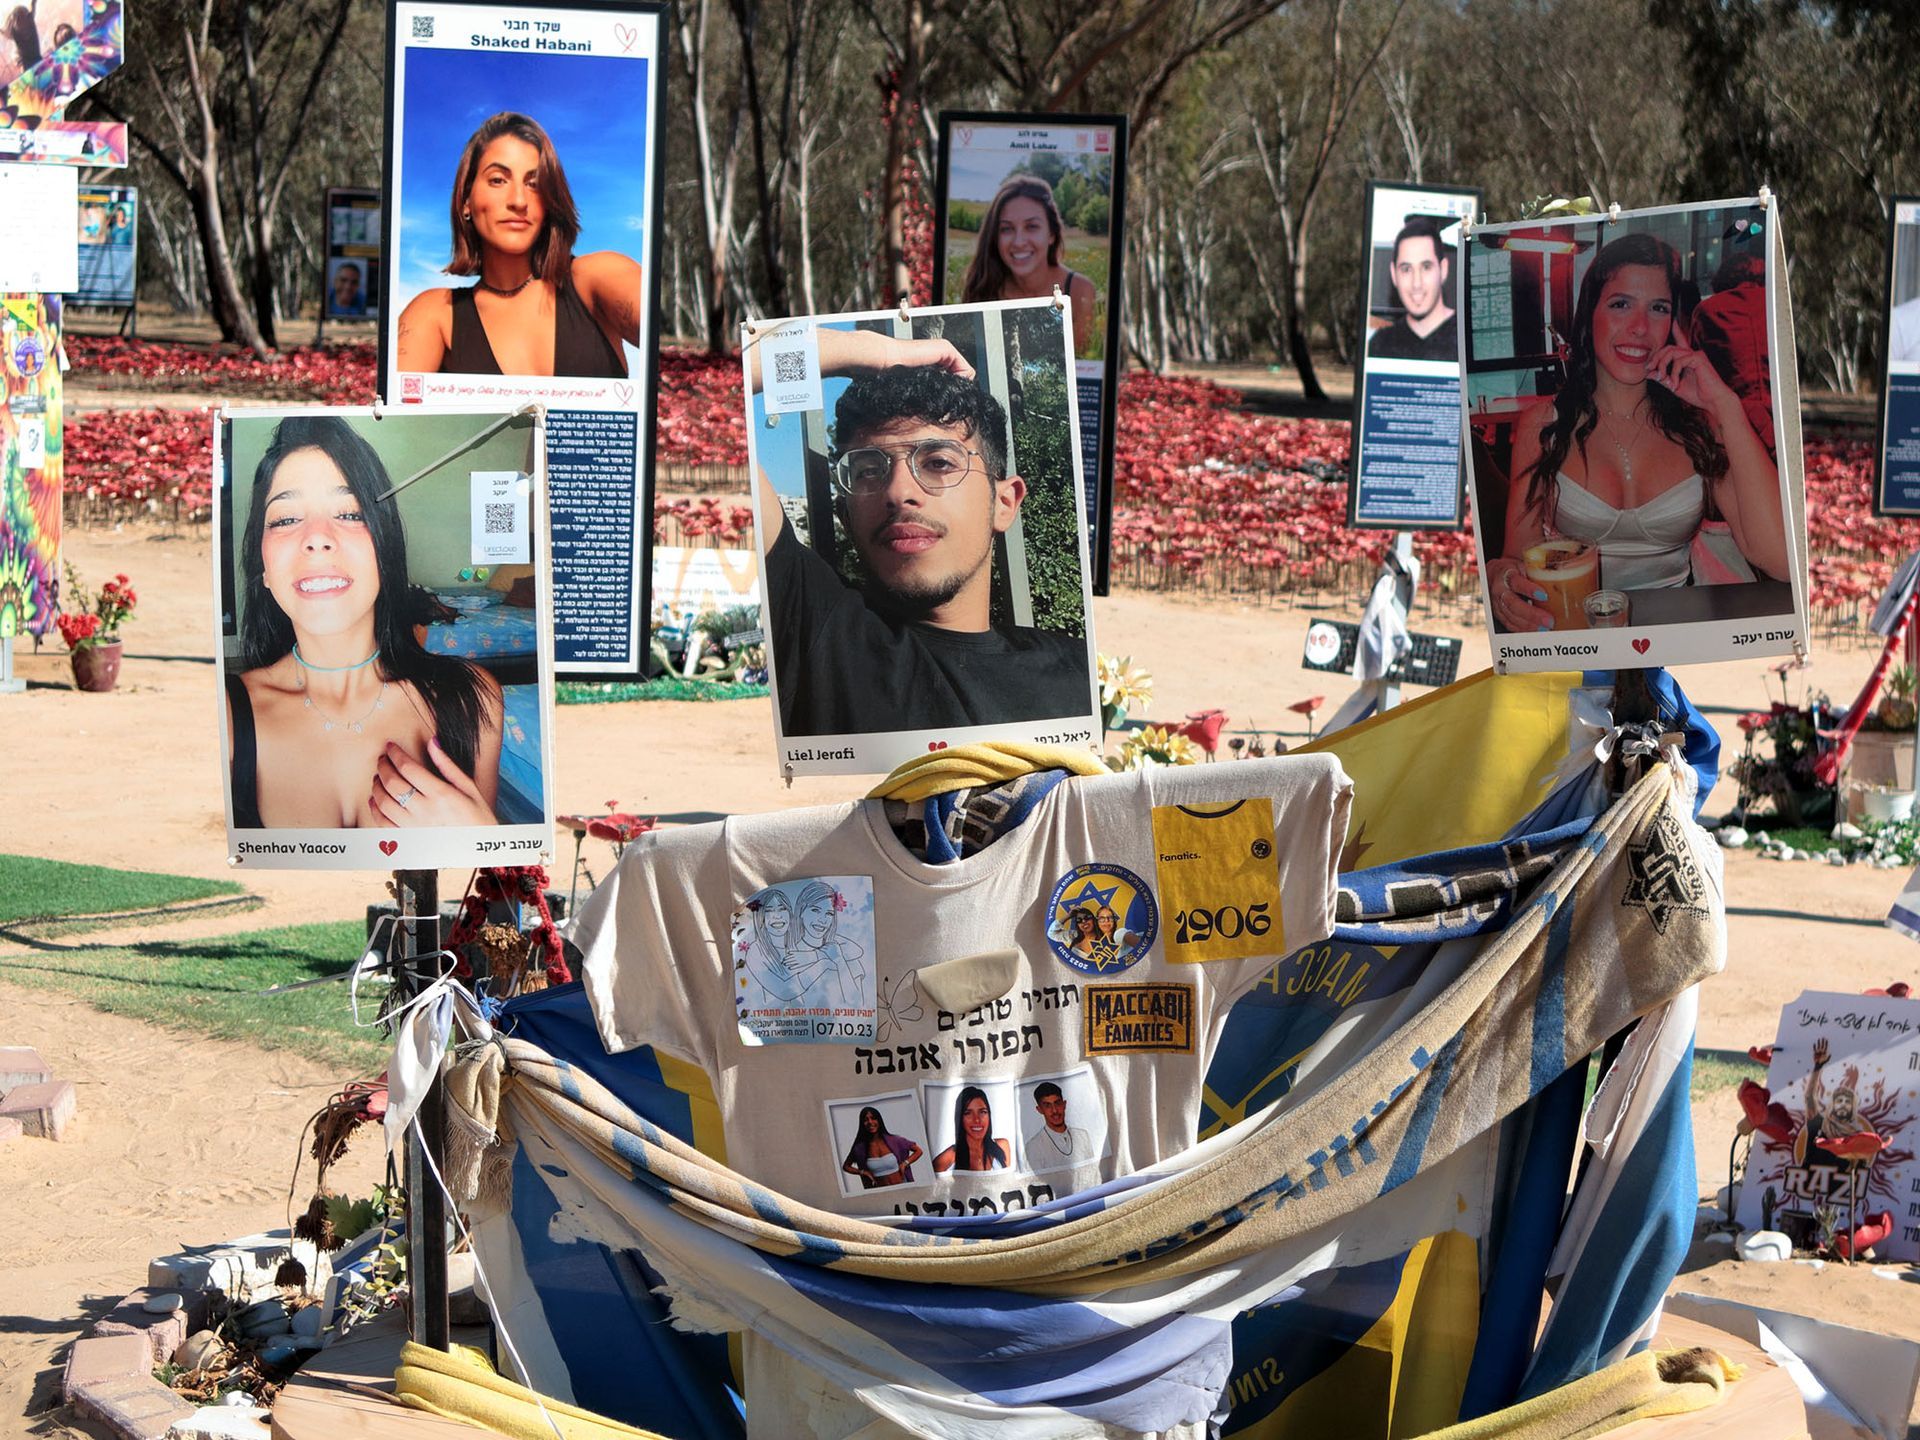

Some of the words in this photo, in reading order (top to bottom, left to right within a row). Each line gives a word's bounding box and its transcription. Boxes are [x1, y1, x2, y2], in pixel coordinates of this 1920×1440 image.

[503, 20, 529, 31] חבני
[533, 21, 560, 33] שקד
[471, 34, 530, 49] Shaked
[535, 38, 592, 52] Habani
[1009, 141, 1030, 149] Amit
[1032, 142, 1058, 150] Lahav
[1732, 631, 1762, 645] יעקב
[1766, 629, 1795, 642] שהם
[1500, 645, 1552, 659] Shoham
[1557, 644, 1599, 657] Yaacov
[1063, 730, 1091, 743] ליאל
[787, 749, 814, 762] Liel
[816, 748, 855, 761] Jerafi
[238, 842, 296, 855] Shenhav
[299, 842, 346, 855] Yaacov
[475, 840, 506, 854] יעקב
[510, 839, 543, 851] שנהב
[1159, 851, 1202, 862] Fanatics.
[1174, 902, 1271, 944] 1906
[1069, 957, 1089, 970] 2023
[1022, 984, 1079, 1011] תהיו
[1095, 992, 1183, 1027] MACCABI
[1868, 1012, 1887, 1031] לא
[816, 1022, 873, 1037] 07.10.23
[1105, 1023, 1174, 1043] FANATICS
[953, 1025, 1043, 1065] תפזרו
[854, 1042, 942, 1075] אהבה
[1783, 1164, 1872, 1207] RAZI
